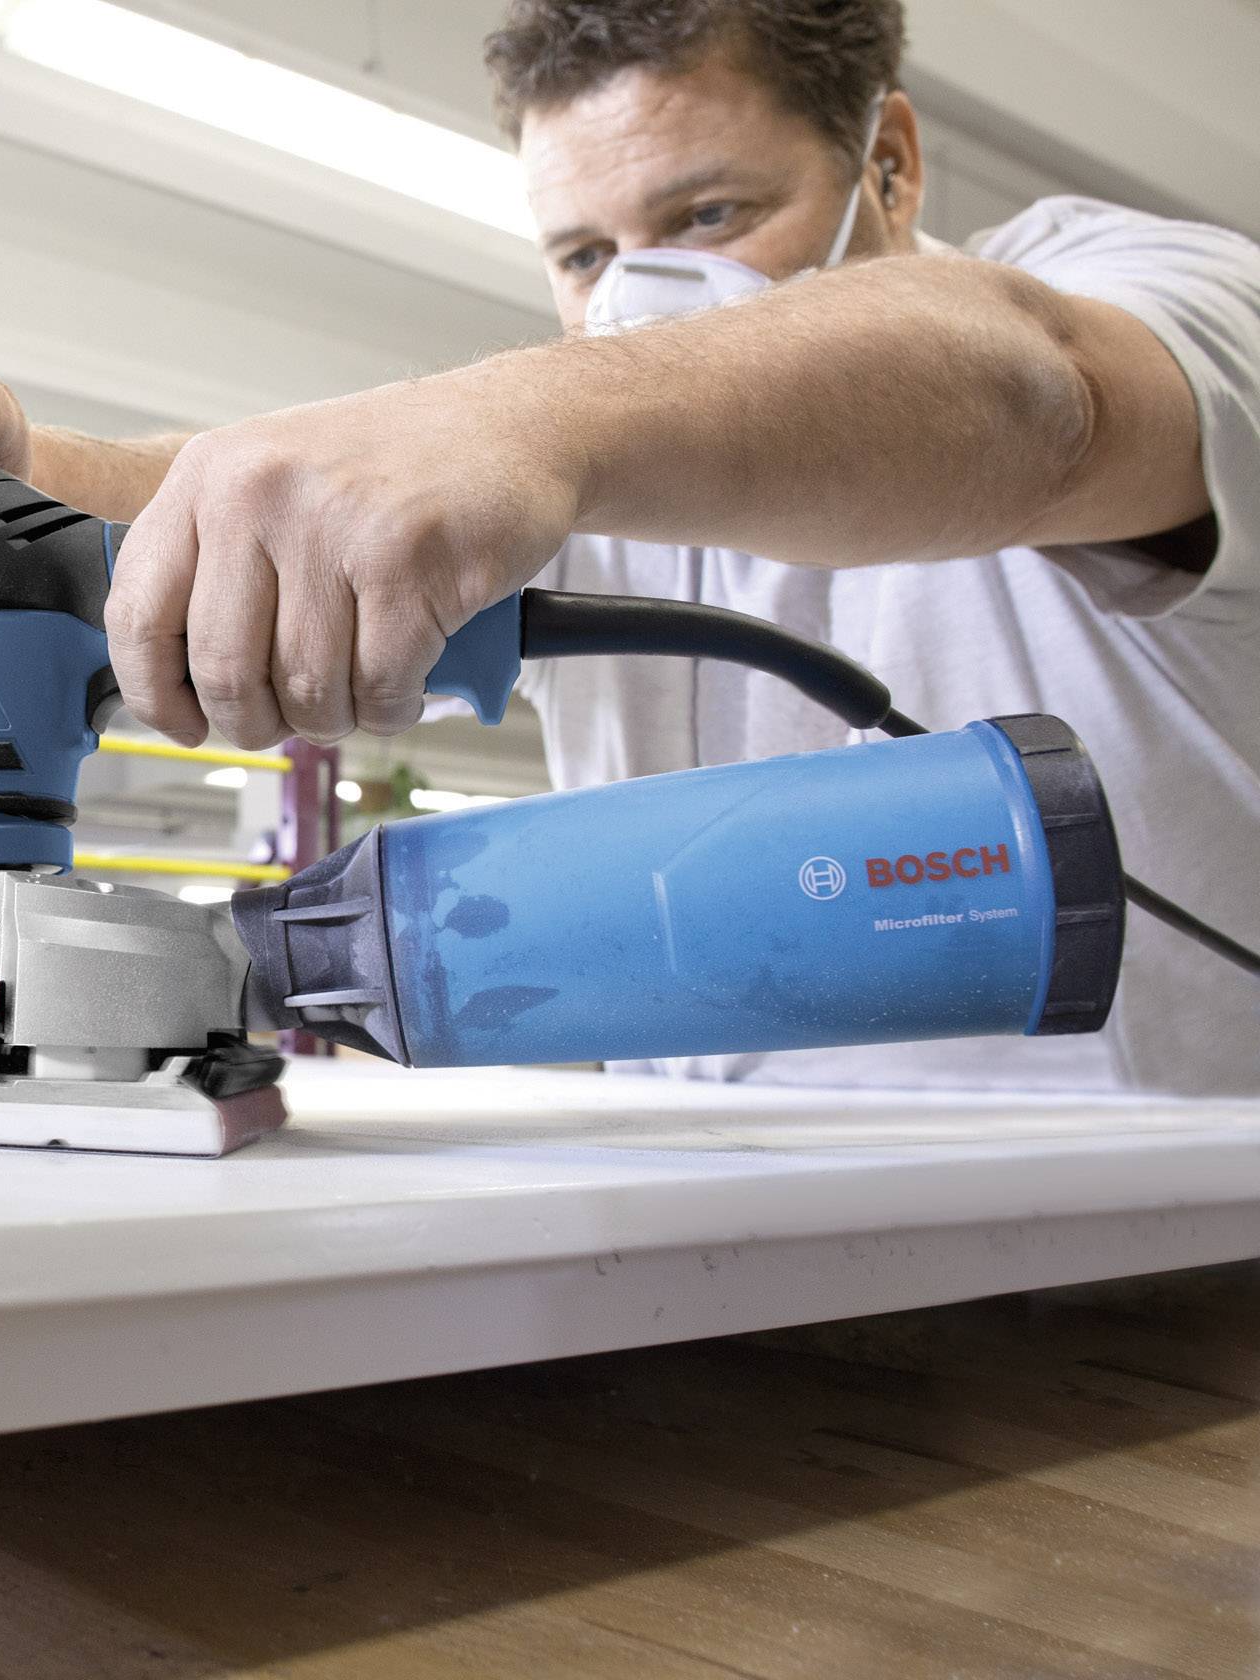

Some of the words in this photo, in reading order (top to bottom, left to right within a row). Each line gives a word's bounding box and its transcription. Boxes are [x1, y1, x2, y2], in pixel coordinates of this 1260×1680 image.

[866, 843, 1011, 888] BOSCH
[873, 912, 964, 932] Microfilter
[969, 907, 1019, 924] System
